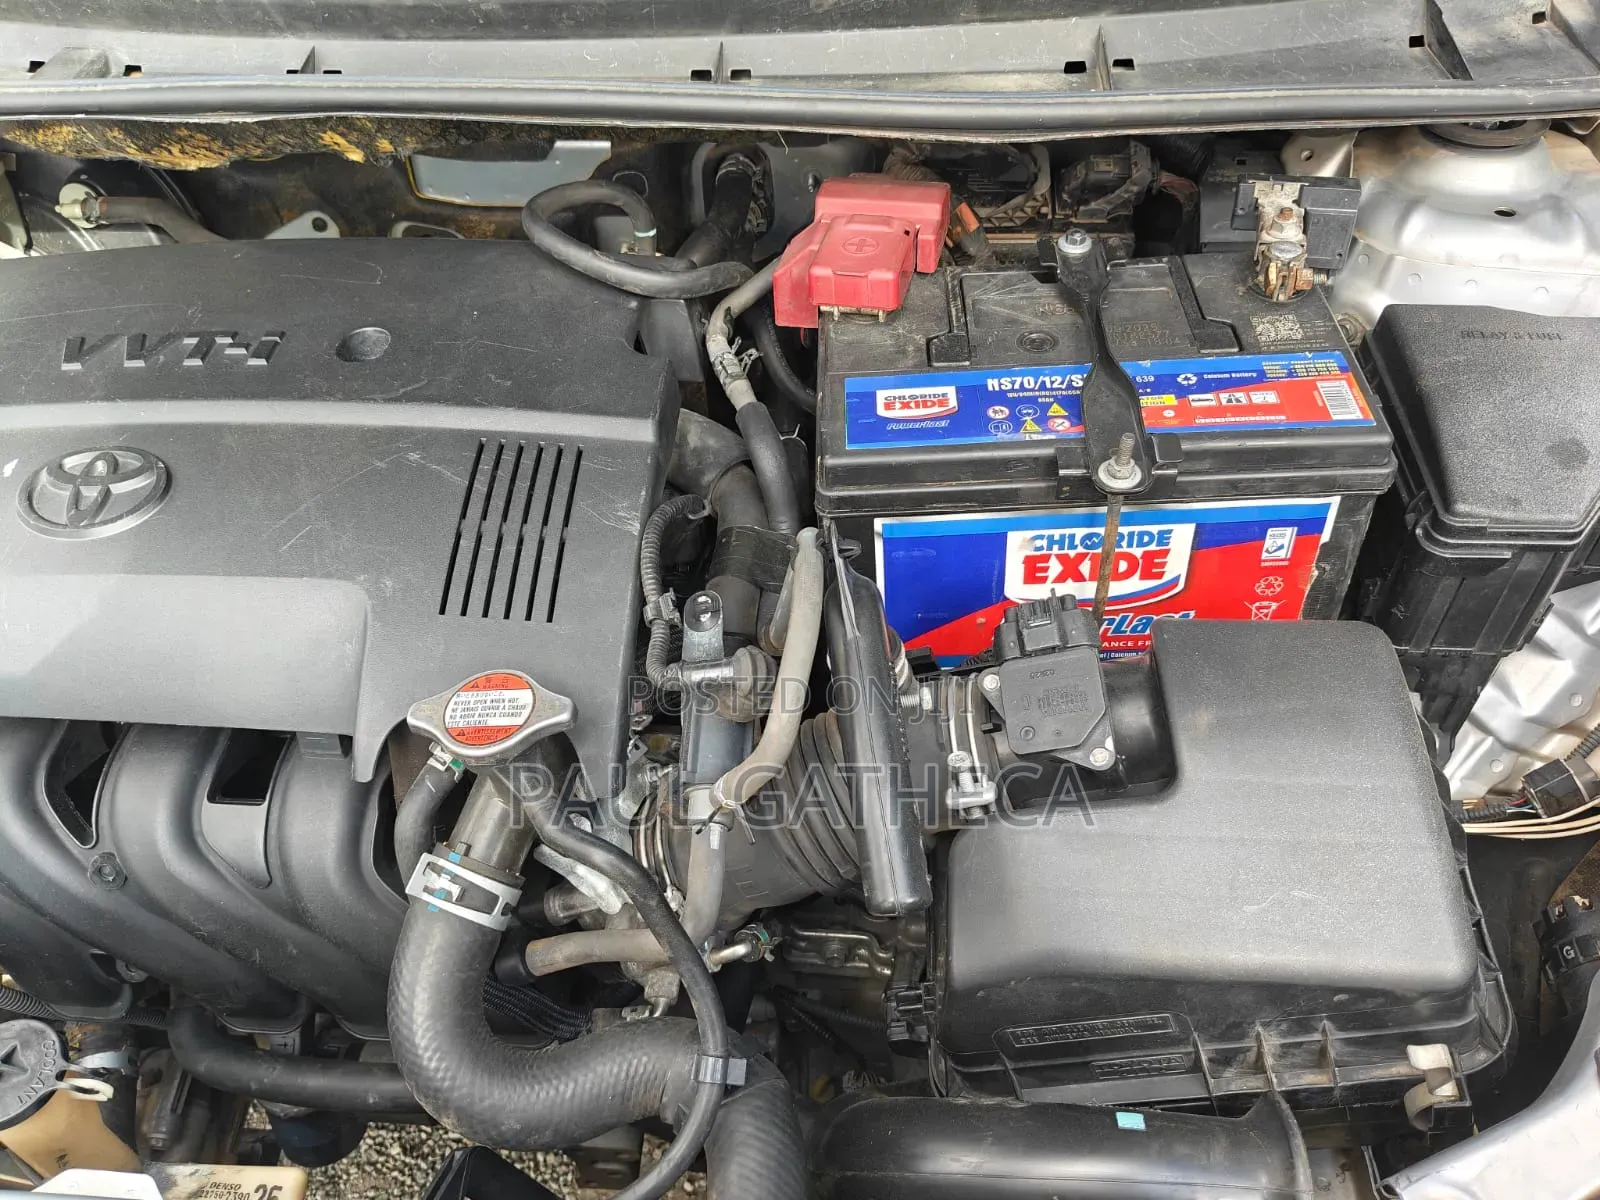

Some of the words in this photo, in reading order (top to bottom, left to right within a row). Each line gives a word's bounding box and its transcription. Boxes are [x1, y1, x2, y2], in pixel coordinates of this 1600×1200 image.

[987, 373, 1088, 391] NS70/12/S
[884, 392, 949, 402] CHLORIDE
[884, 398, 950, 411] EXIDE
[1029, 529, 1174, 551] CHLORIDE
[1022, 548, 1172, 585] EXIDE
[17, 1039, 57, 1106] COOLANT
[210, 1181, 242, 1191] DENSO
